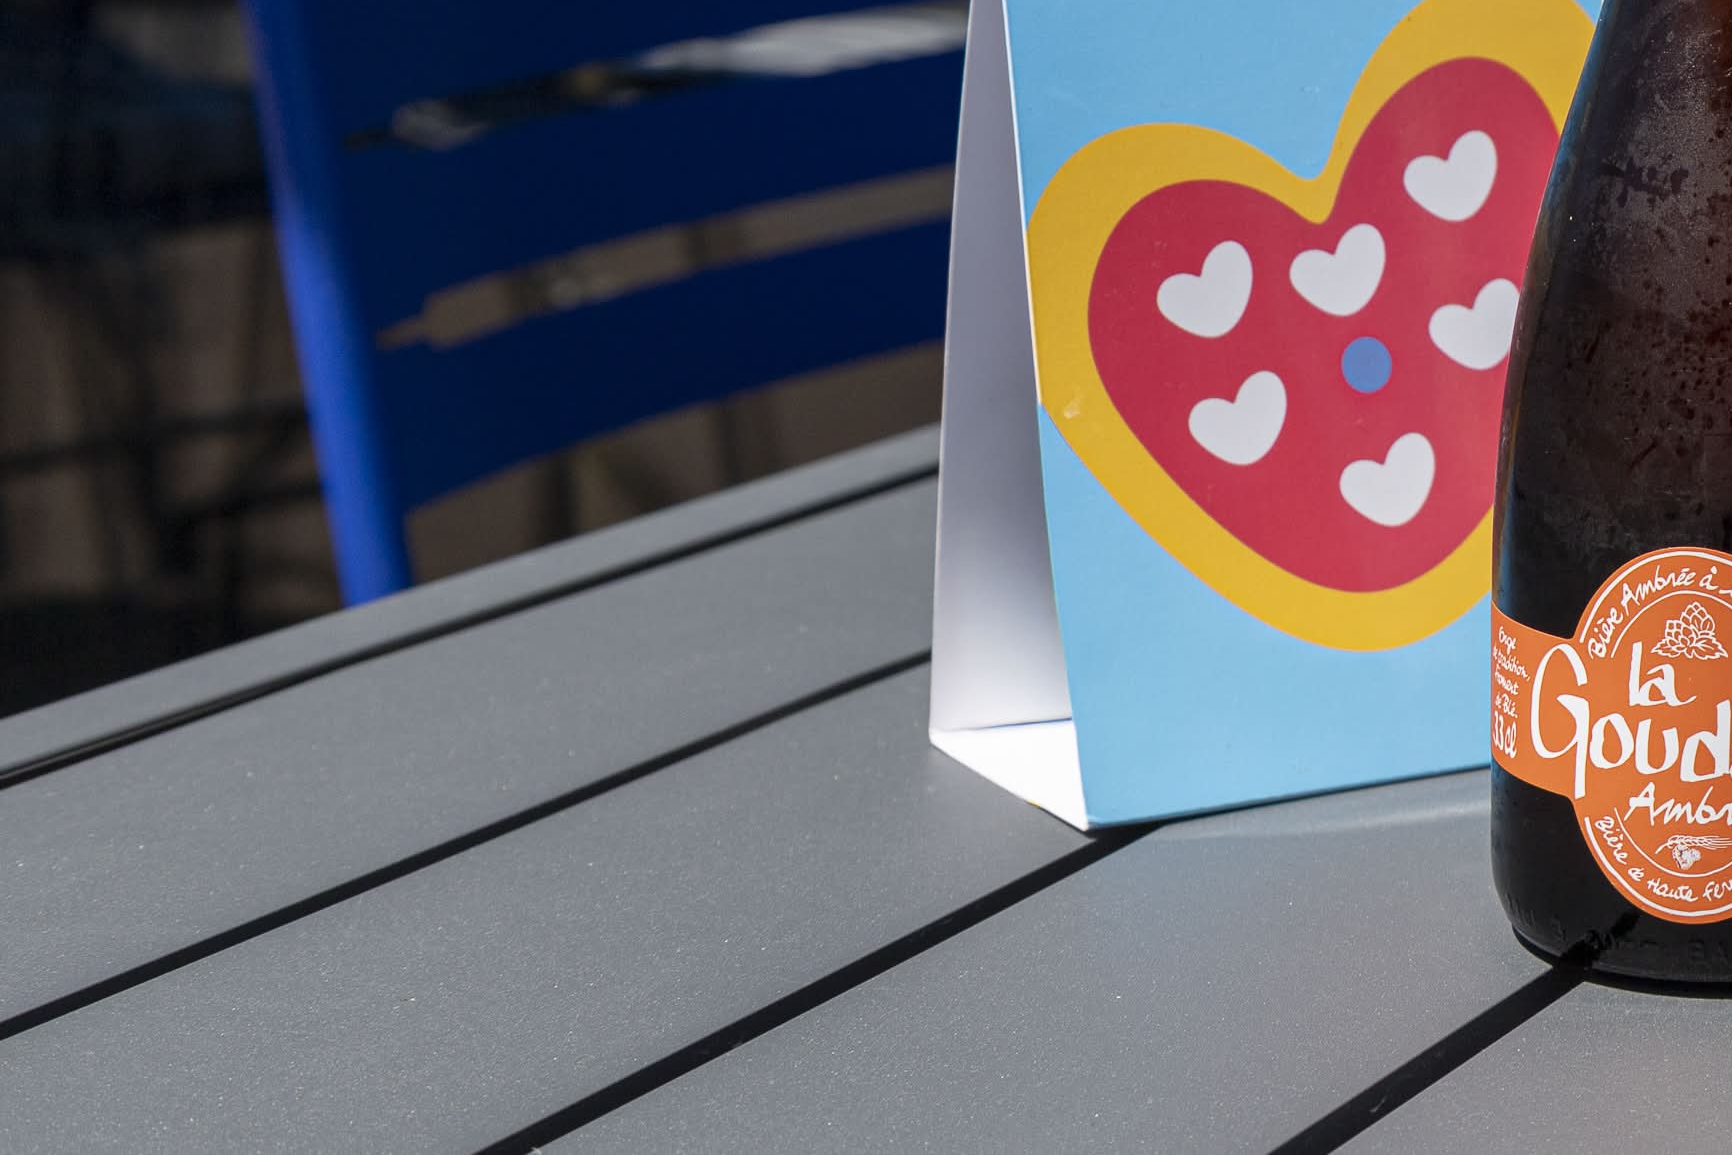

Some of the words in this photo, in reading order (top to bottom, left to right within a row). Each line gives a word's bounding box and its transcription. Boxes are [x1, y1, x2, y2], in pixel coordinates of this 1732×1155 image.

[1588, 607, 1623, 659] Bière
[1621, 565, 1696, 616] Ambrée
[1699, 565, 1720, 590] à
[1629, 641, 1697, 707] la
[1595, 816, 1627, 865] Bière
[1647, 877, 1699, 902] Haute
